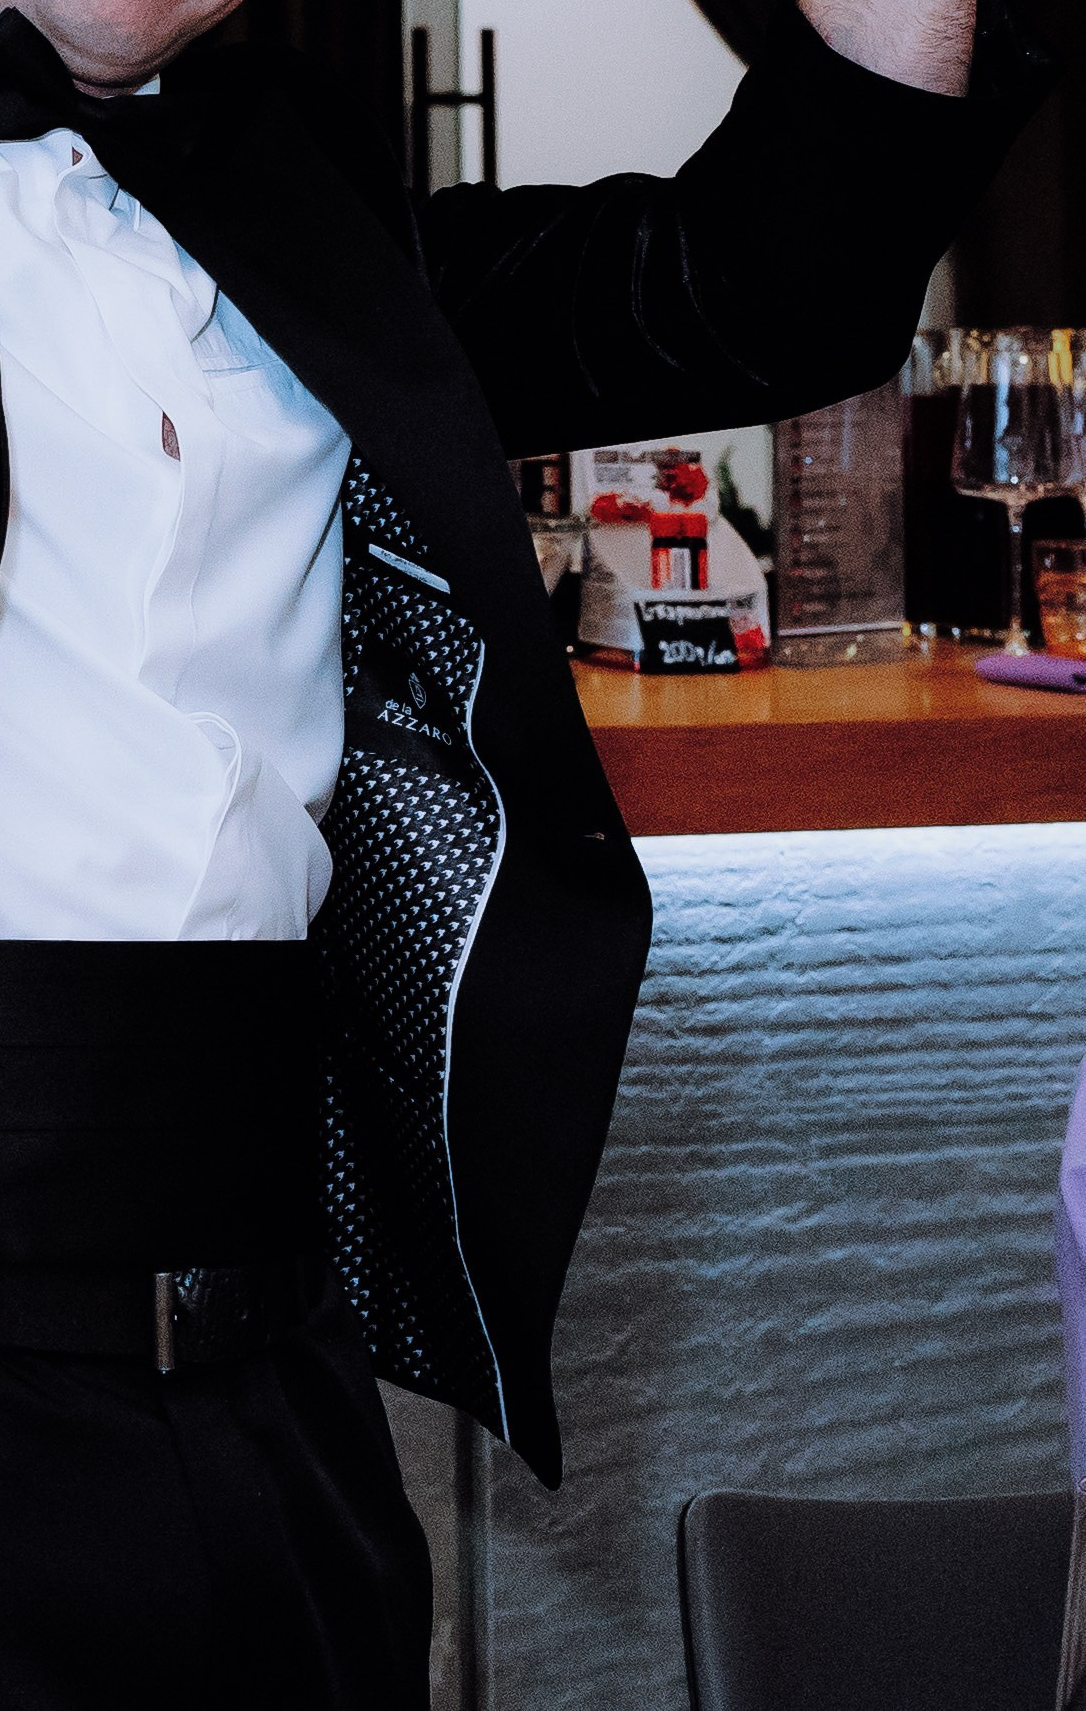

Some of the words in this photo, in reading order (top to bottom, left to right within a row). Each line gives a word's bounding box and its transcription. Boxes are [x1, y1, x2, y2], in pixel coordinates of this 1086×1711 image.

[385, 699, 399, 711] de
[402, 702, 412, 716] la
[377, 709, 452, 746] AZZARO
